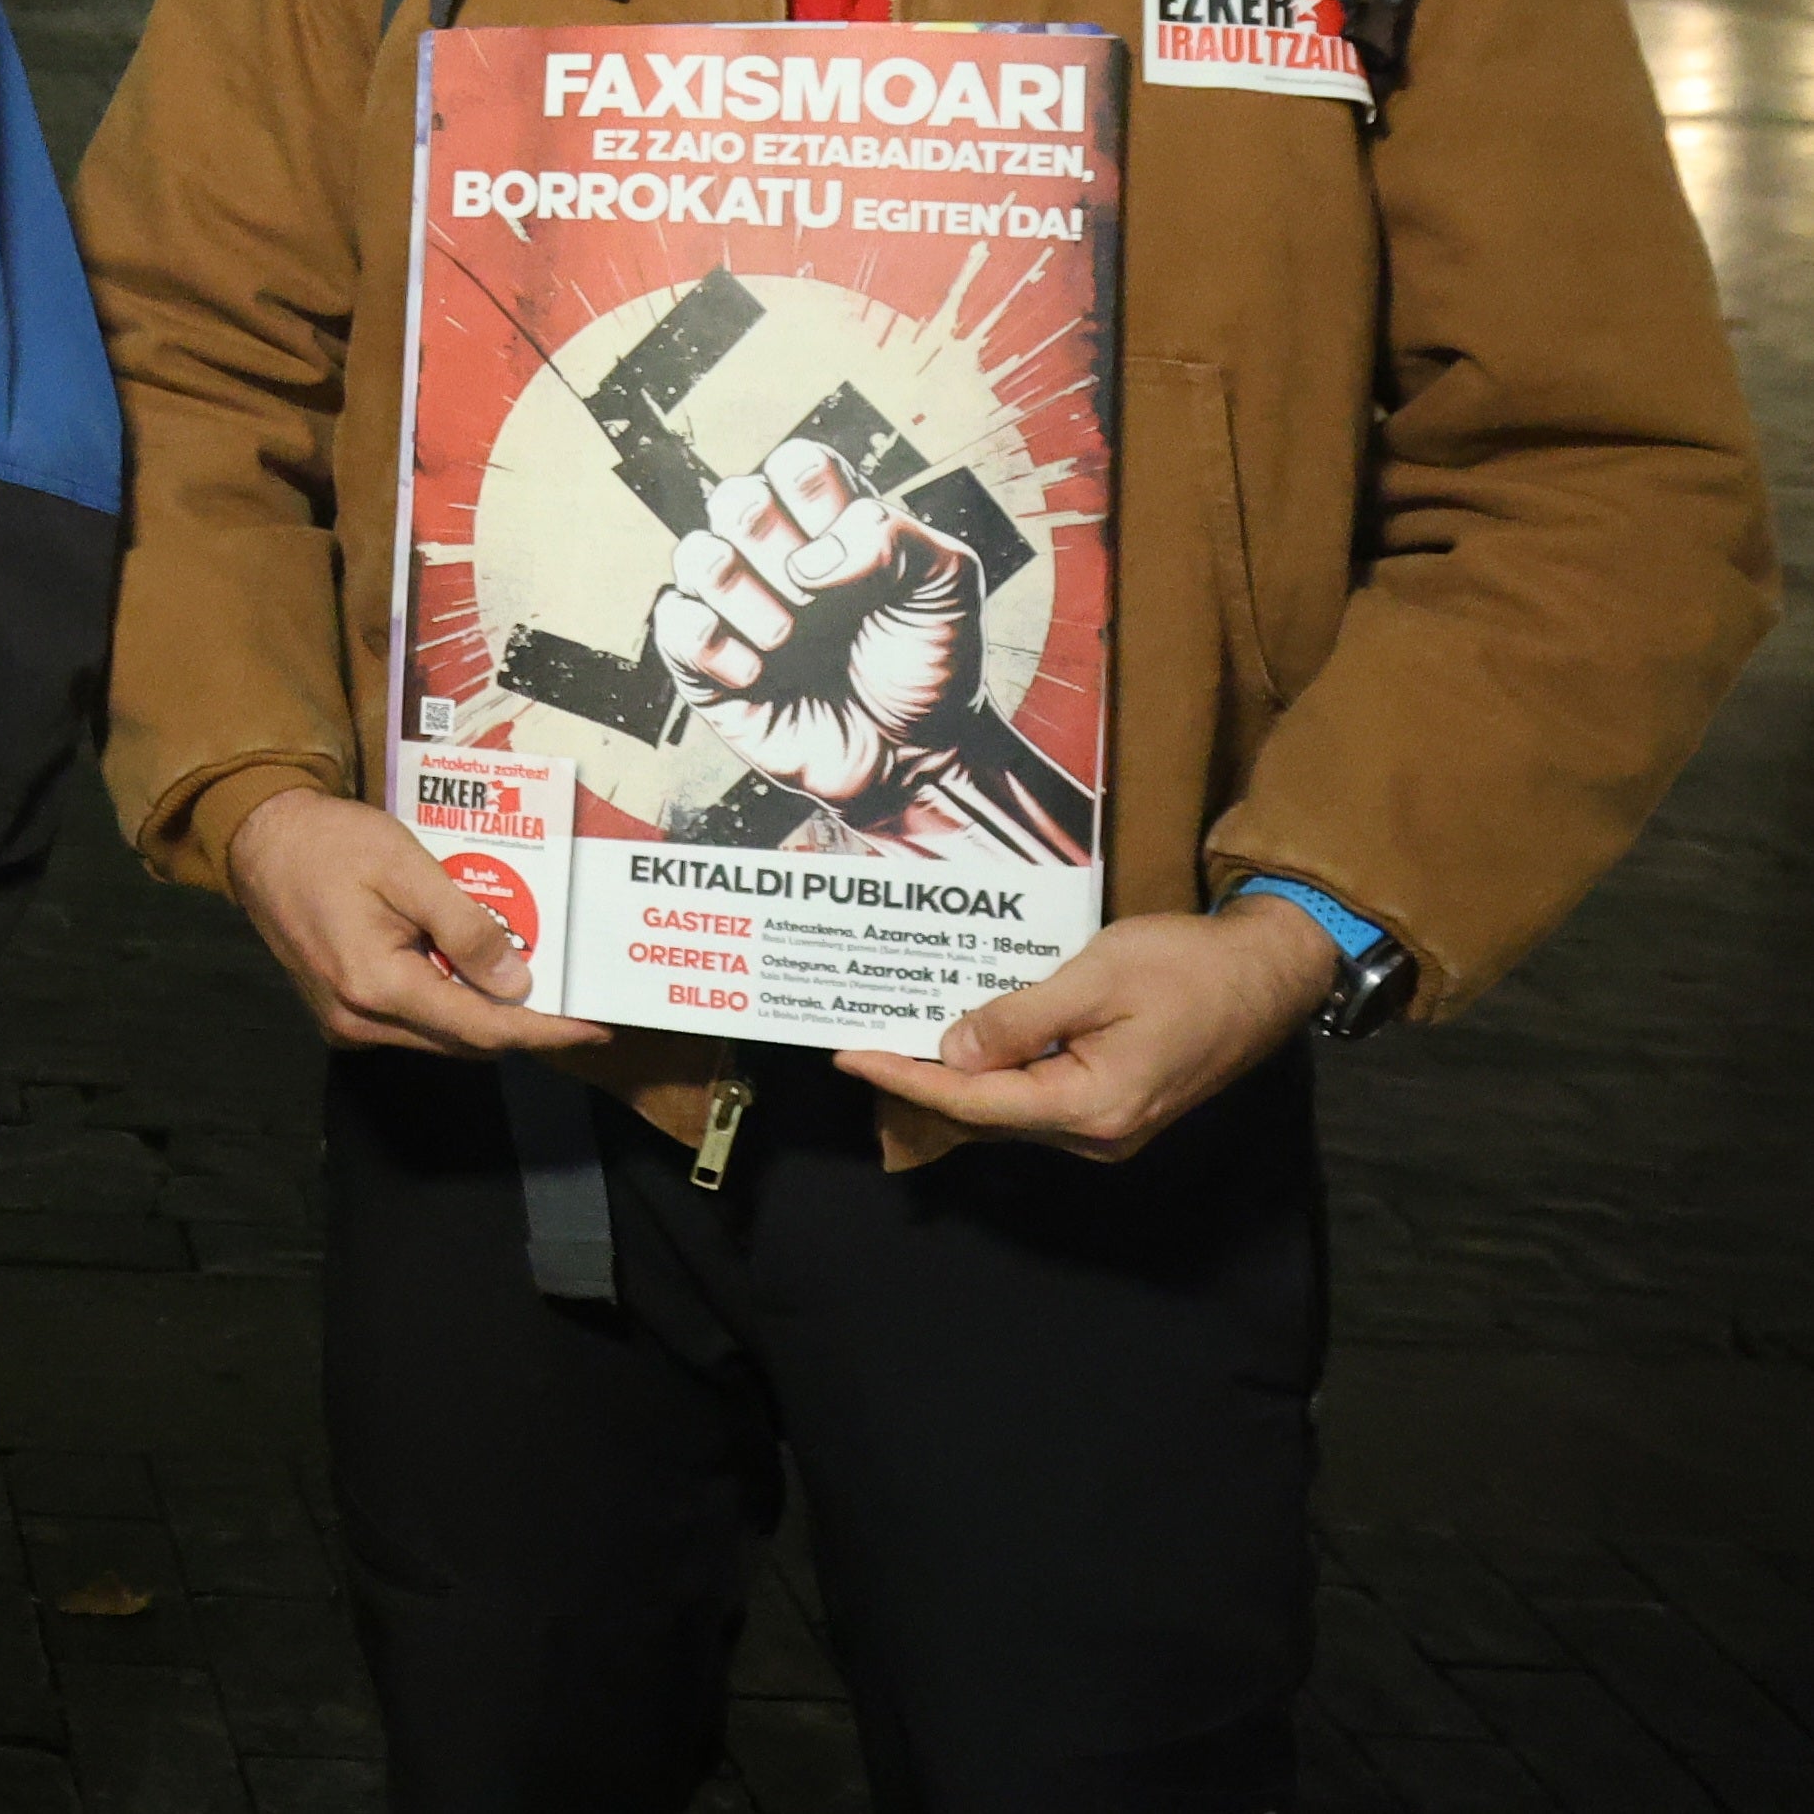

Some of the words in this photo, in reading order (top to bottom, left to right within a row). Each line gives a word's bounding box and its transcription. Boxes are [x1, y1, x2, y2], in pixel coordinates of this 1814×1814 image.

[543, 52, 1085, 132] FAXISMOARI
[592, 129, 640, 162] EZ
[645, 130, 745, 166] ZAIO
[752, 132, 1096, 183] EZTABAIDATZEN,
[451, 170, 844, 230] BORROKATU
[852, 198, 1000, 237] EGITEN
[1007, 205, 1084, 242] DA!
[421, 753, 489, 776] Antolatu
[418, 774, 486, 810] EZKER
[417, 803, 546, 841] IRAULTZAILEA
[630, 855, 794, 900] EKITALDI
[801, 874, 1025, 922] PUBLIKOAK
[642, 906, 752, 938] GASTEIZ
[864, 923, 951, 947] Azaroak
[957, 933, 977, 950] 13
[993, 937, 1060, 957] 18etan
[628, 941, 750, 976] ORERETA
[846, 959, 935, 983] Azaroak
[940, 969, 959, 985] 14
[977, 972, 1033, 992] 18eta
[668, 984, 749, 1012] BILBO
[832, 995, 920, 1019] Azaroak
[926, 1005, 945, 1021] 15
